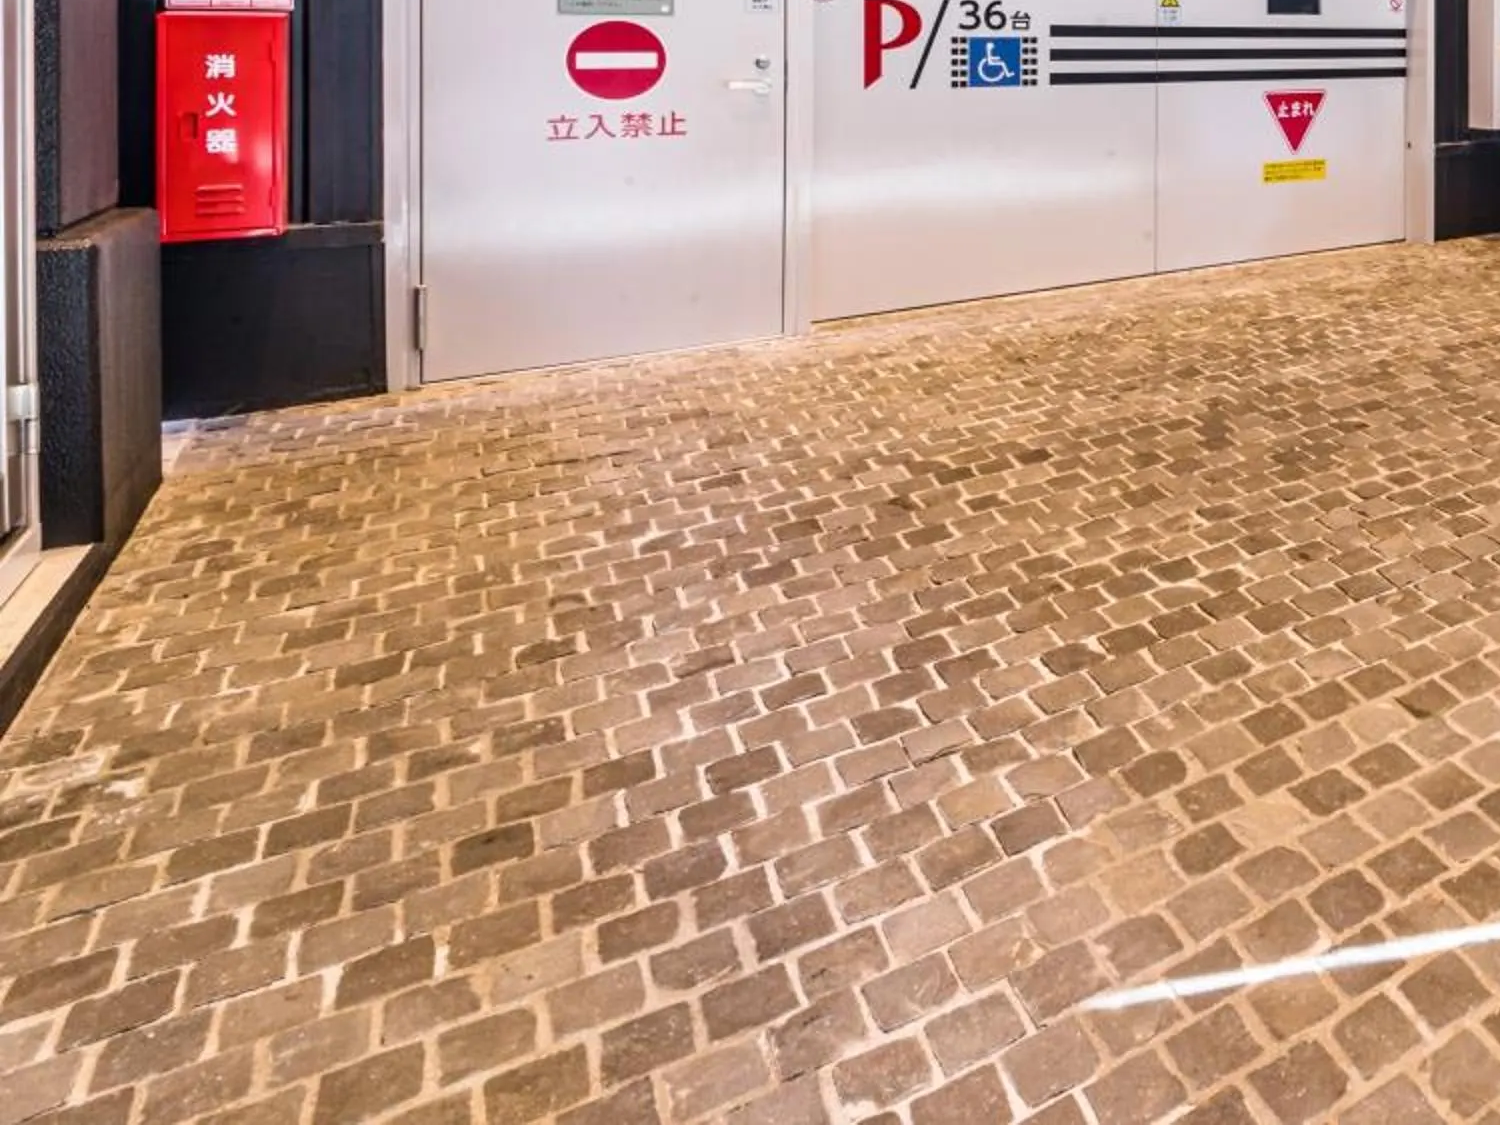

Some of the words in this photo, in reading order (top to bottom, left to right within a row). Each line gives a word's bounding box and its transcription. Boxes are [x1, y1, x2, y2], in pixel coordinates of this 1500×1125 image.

[204, 54, 239, 155] 消火器
[1277, 100, 1315, 119] 止まれ
[546, 111, 688, 142] 立入禁止
